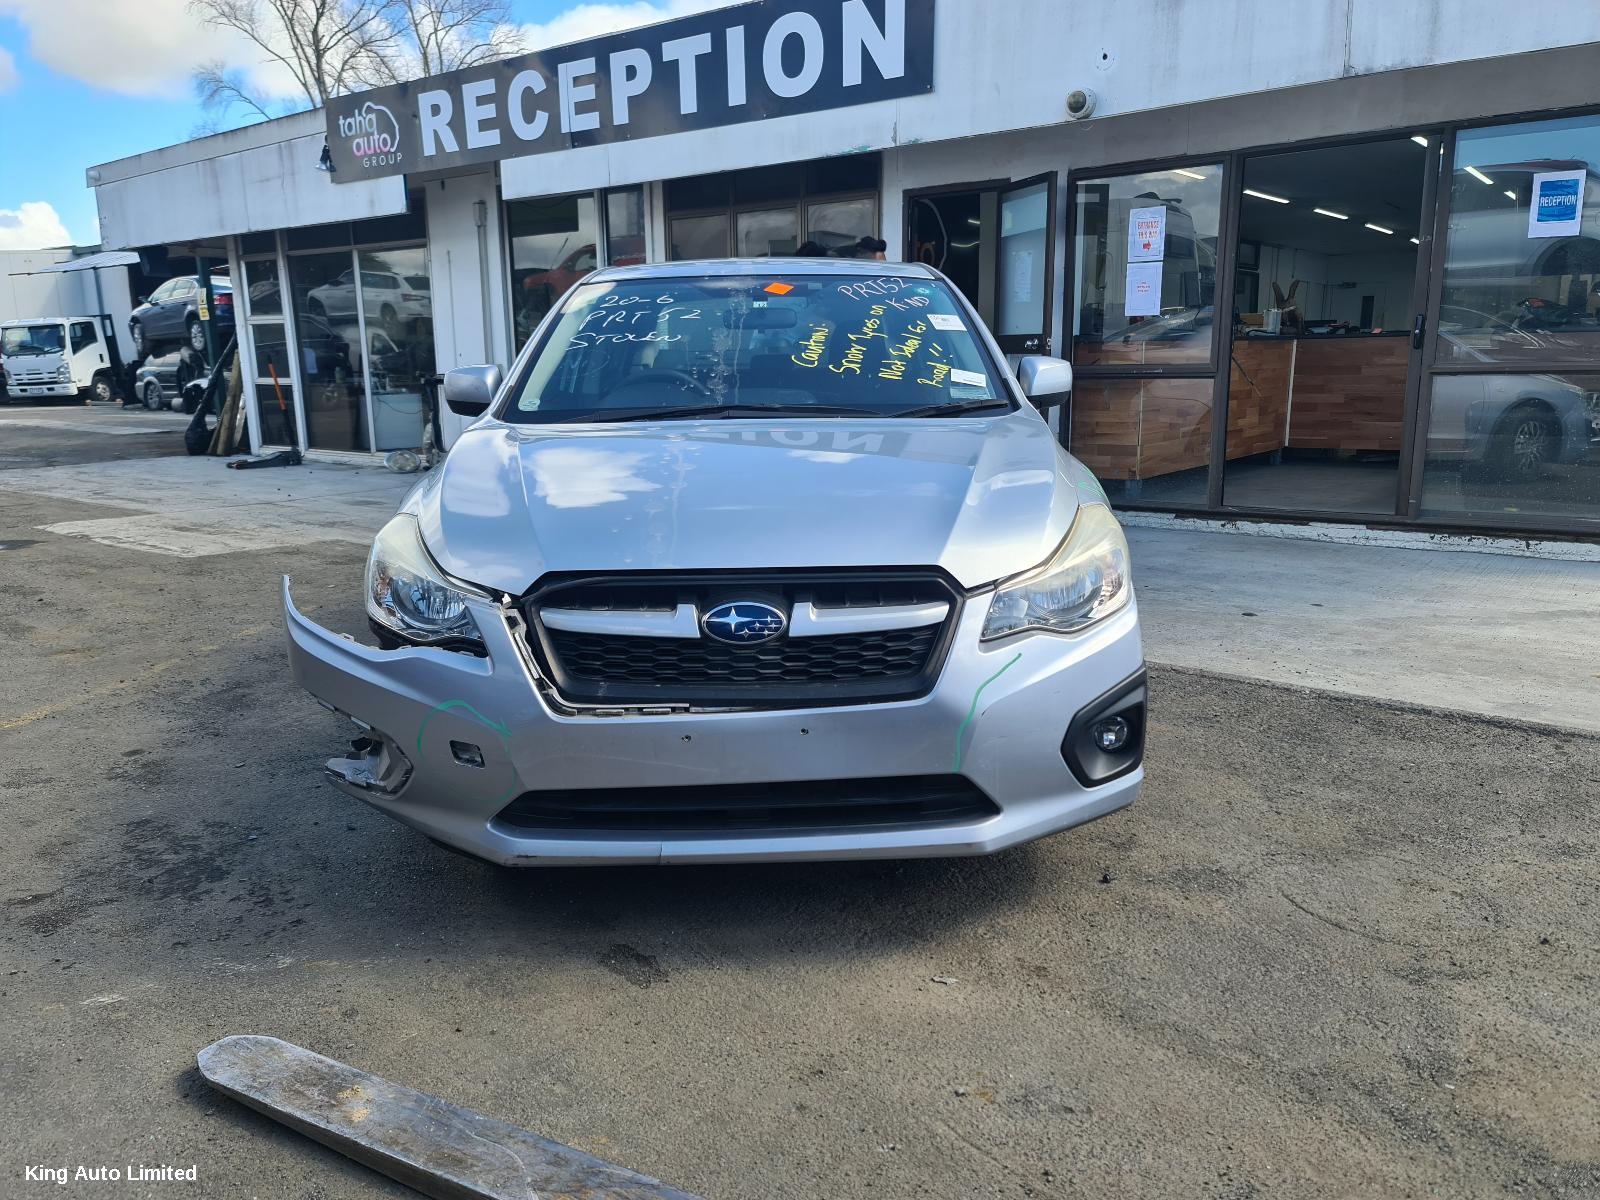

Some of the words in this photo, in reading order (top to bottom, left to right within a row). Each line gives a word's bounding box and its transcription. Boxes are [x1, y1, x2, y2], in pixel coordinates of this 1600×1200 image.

[417, 0, 905, 157] RECEPTION
[338, 109, 377, 138] taha
[352, 132, 391, 157] auto
[362, 152, 403, 168] GROUP
[1540, 194, 1577, 207] RECEPTION
[837, 277, 913, 301] PRT52
[599, 295, 675, 308] 20-6
[869, 304, 887, 316] on
[564, 332, 682, 350] STOLEN
[878, 359, 907, 380] Not
